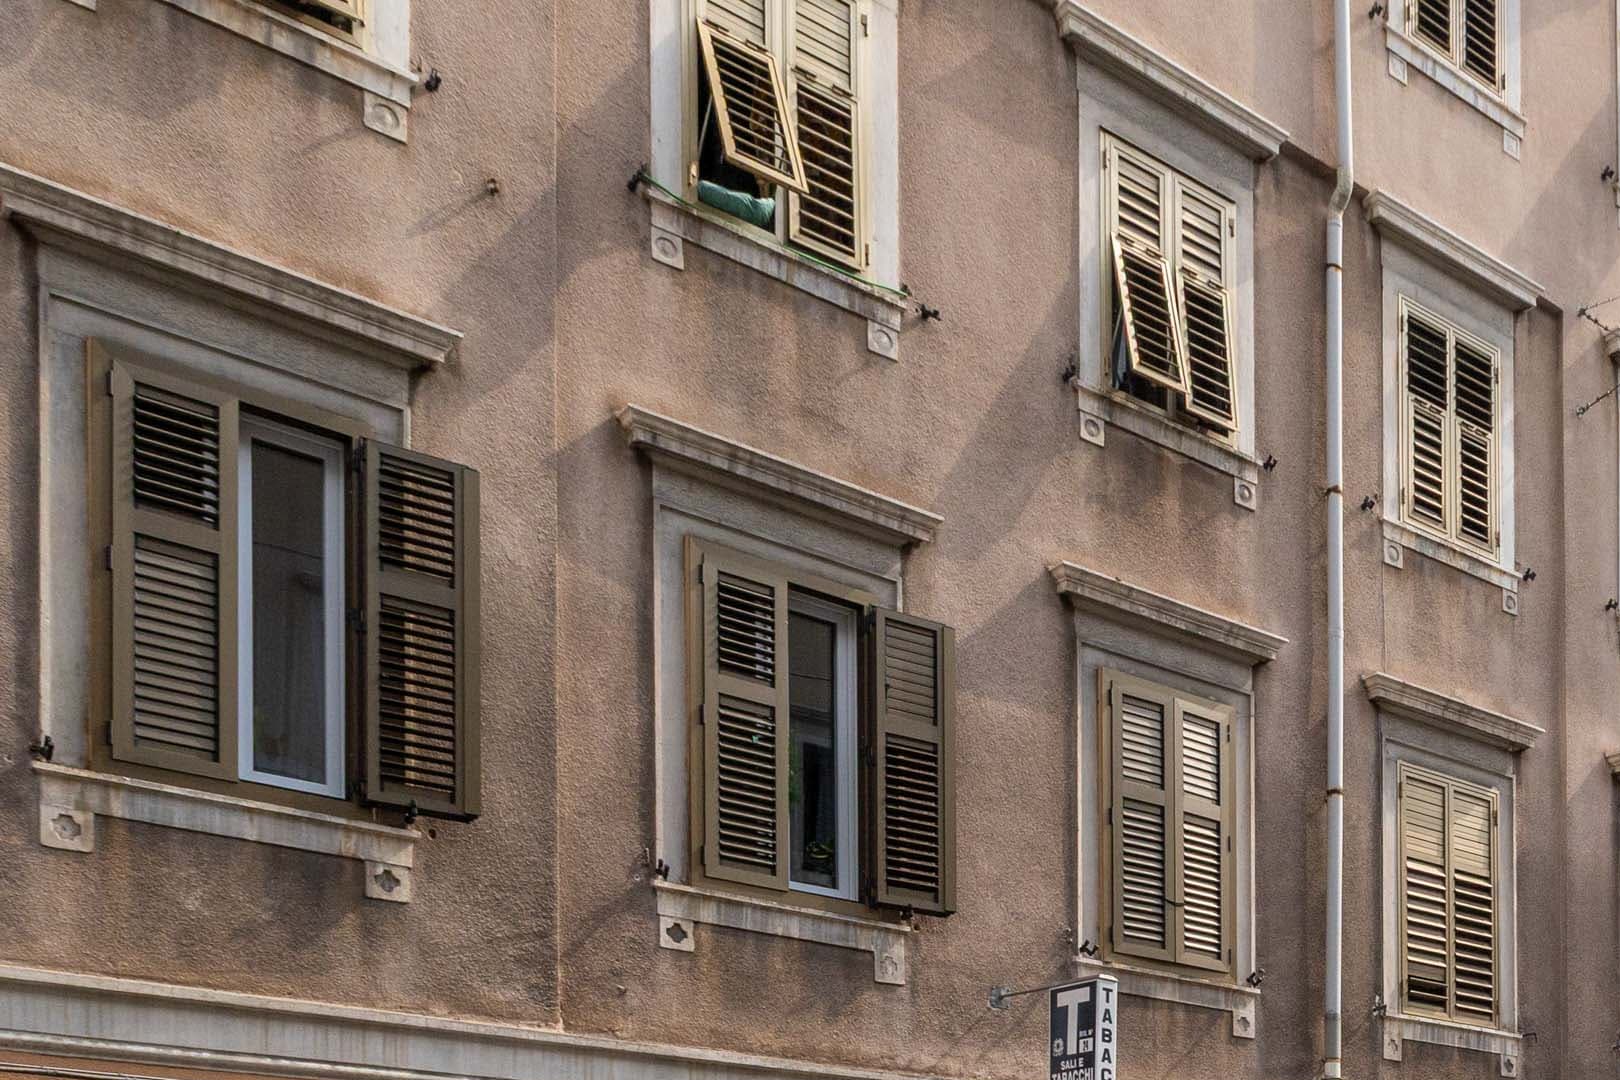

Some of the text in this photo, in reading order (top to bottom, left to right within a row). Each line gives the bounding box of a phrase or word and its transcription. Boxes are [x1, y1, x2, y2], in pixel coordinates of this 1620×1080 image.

[1056, 986, 1090, 1055] T
[1060, 1057, 1084, 1070] SALI E
